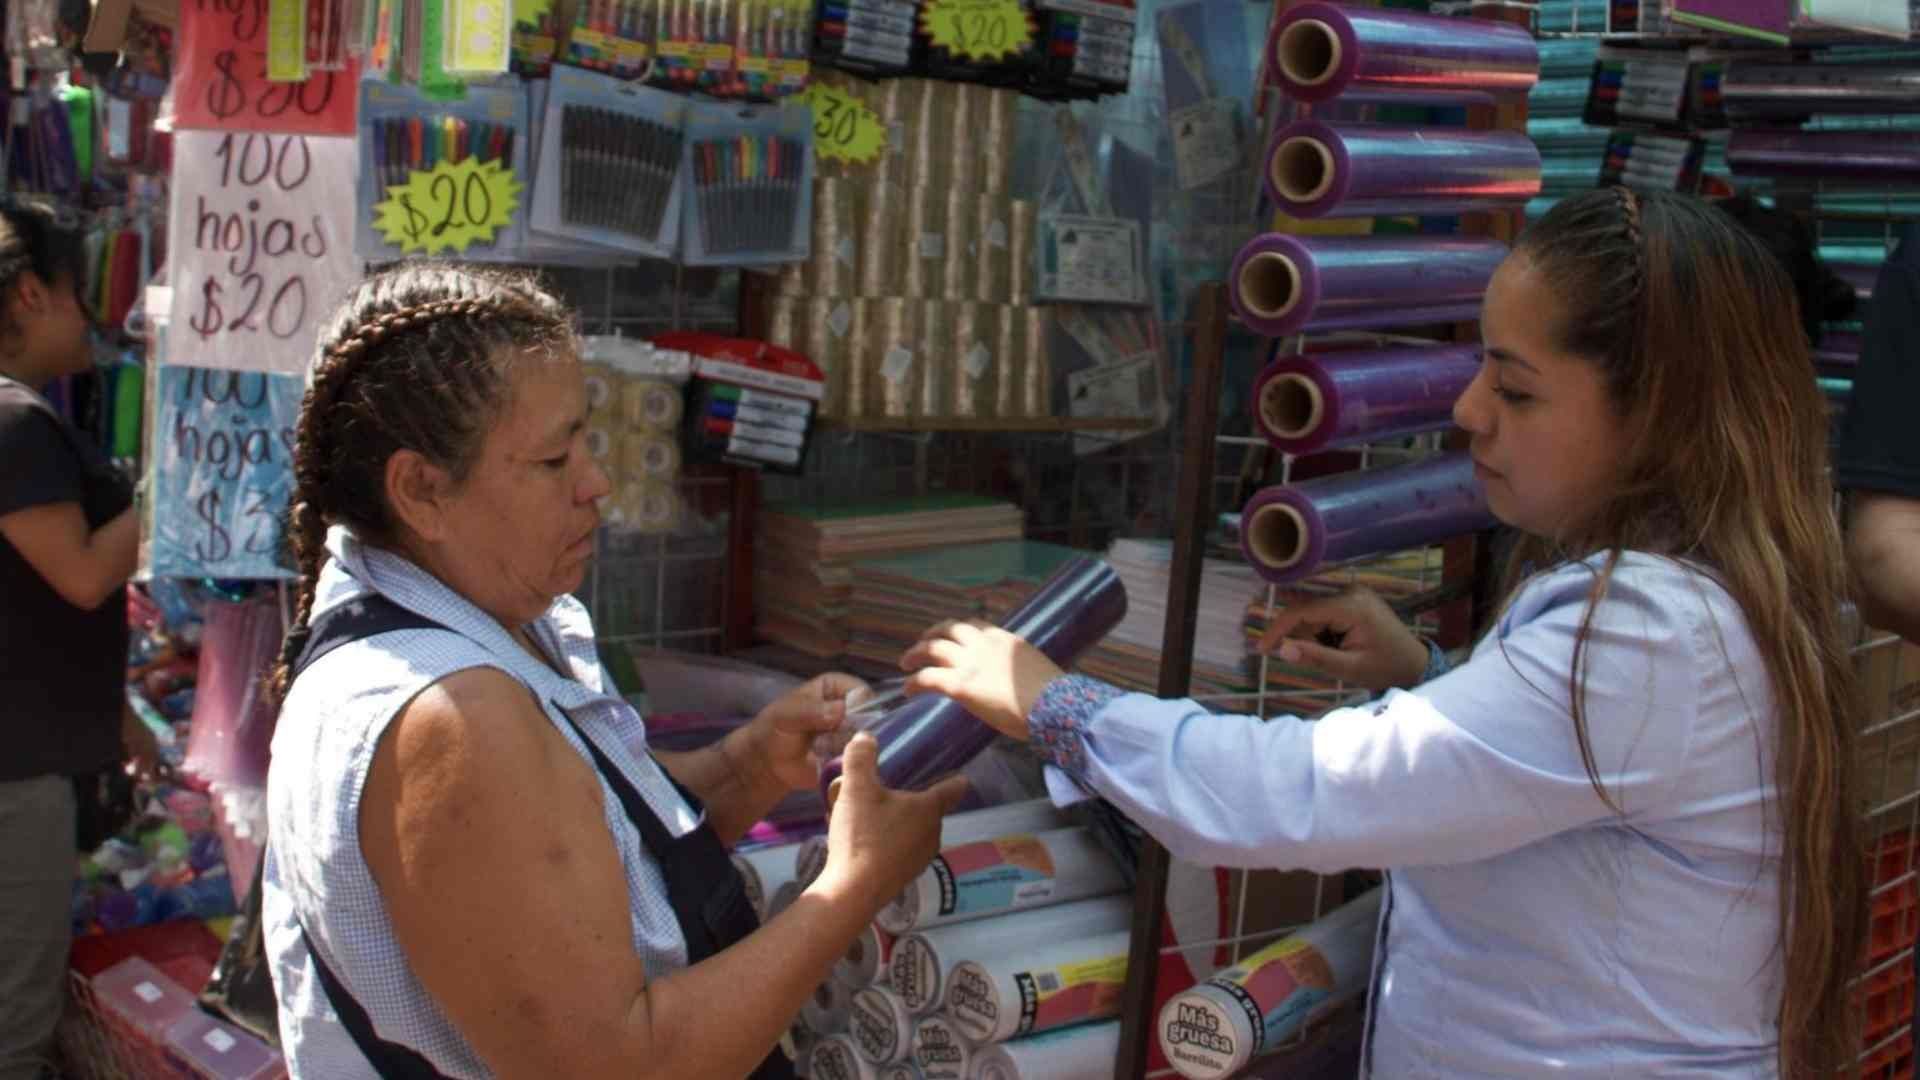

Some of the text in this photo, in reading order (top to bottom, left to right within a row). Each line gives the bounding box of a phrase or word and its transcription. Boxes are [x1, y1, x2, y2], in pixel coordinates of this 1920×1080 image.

[216, 133, 311, 191] 100
[196, 195, 327, 277] hojas
[400, 171, 492, 242] $20
[189, 273, 306, 341] $20
[1167, 1021, 1233, 1055] gruesa
[1178, 1003, 1219, 1032] Más
